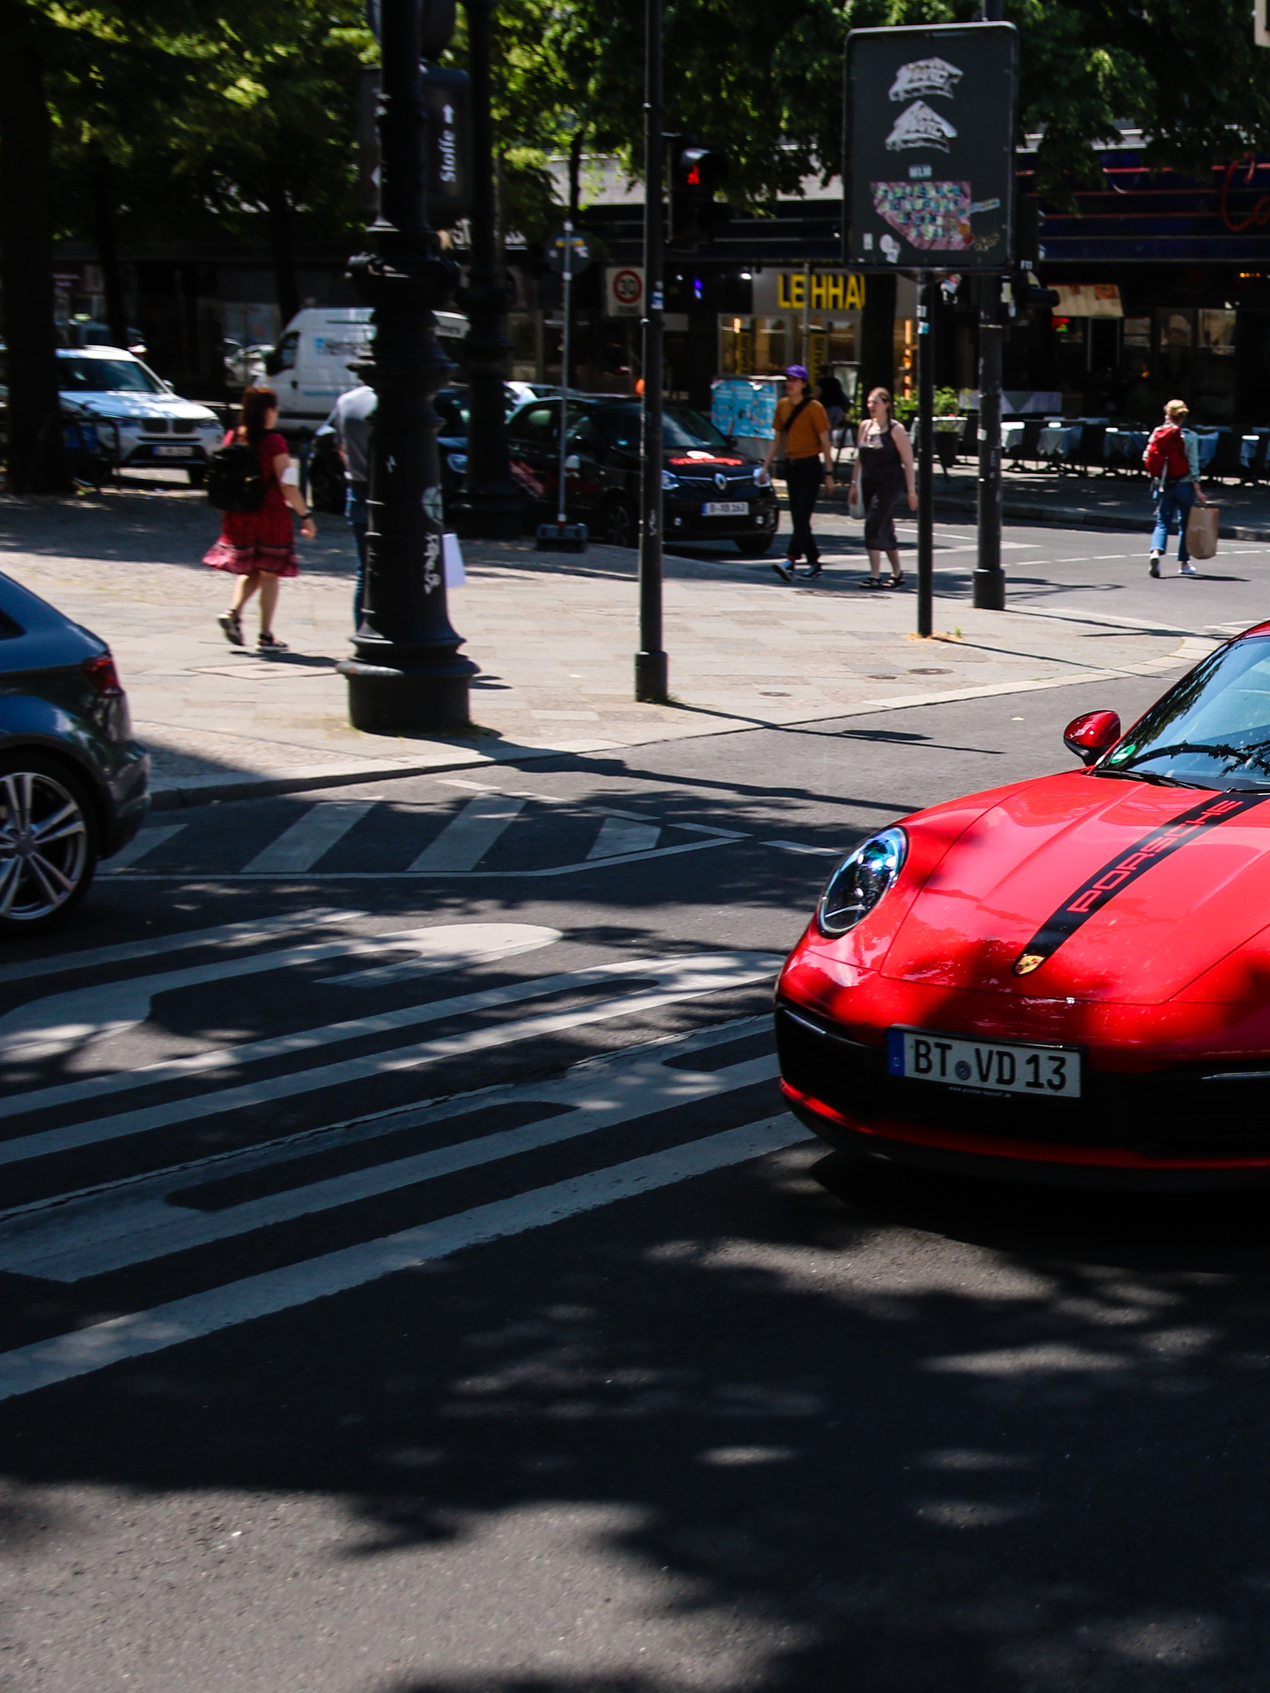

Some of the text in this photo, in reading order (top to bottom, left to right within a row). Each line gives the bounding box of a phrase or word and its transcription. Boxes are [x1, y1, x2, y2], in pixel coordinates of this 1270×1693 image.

[438, 129, 457, 183] Stoffe
[620, 278, 637, 296] 30
[1066, 799, 1245, 914] PORSCHE
[914, 1038, 953, 1077] BT
[974, 1047, 1017, 1086] VD
[1025, 1053, 1067, 1091] 13
